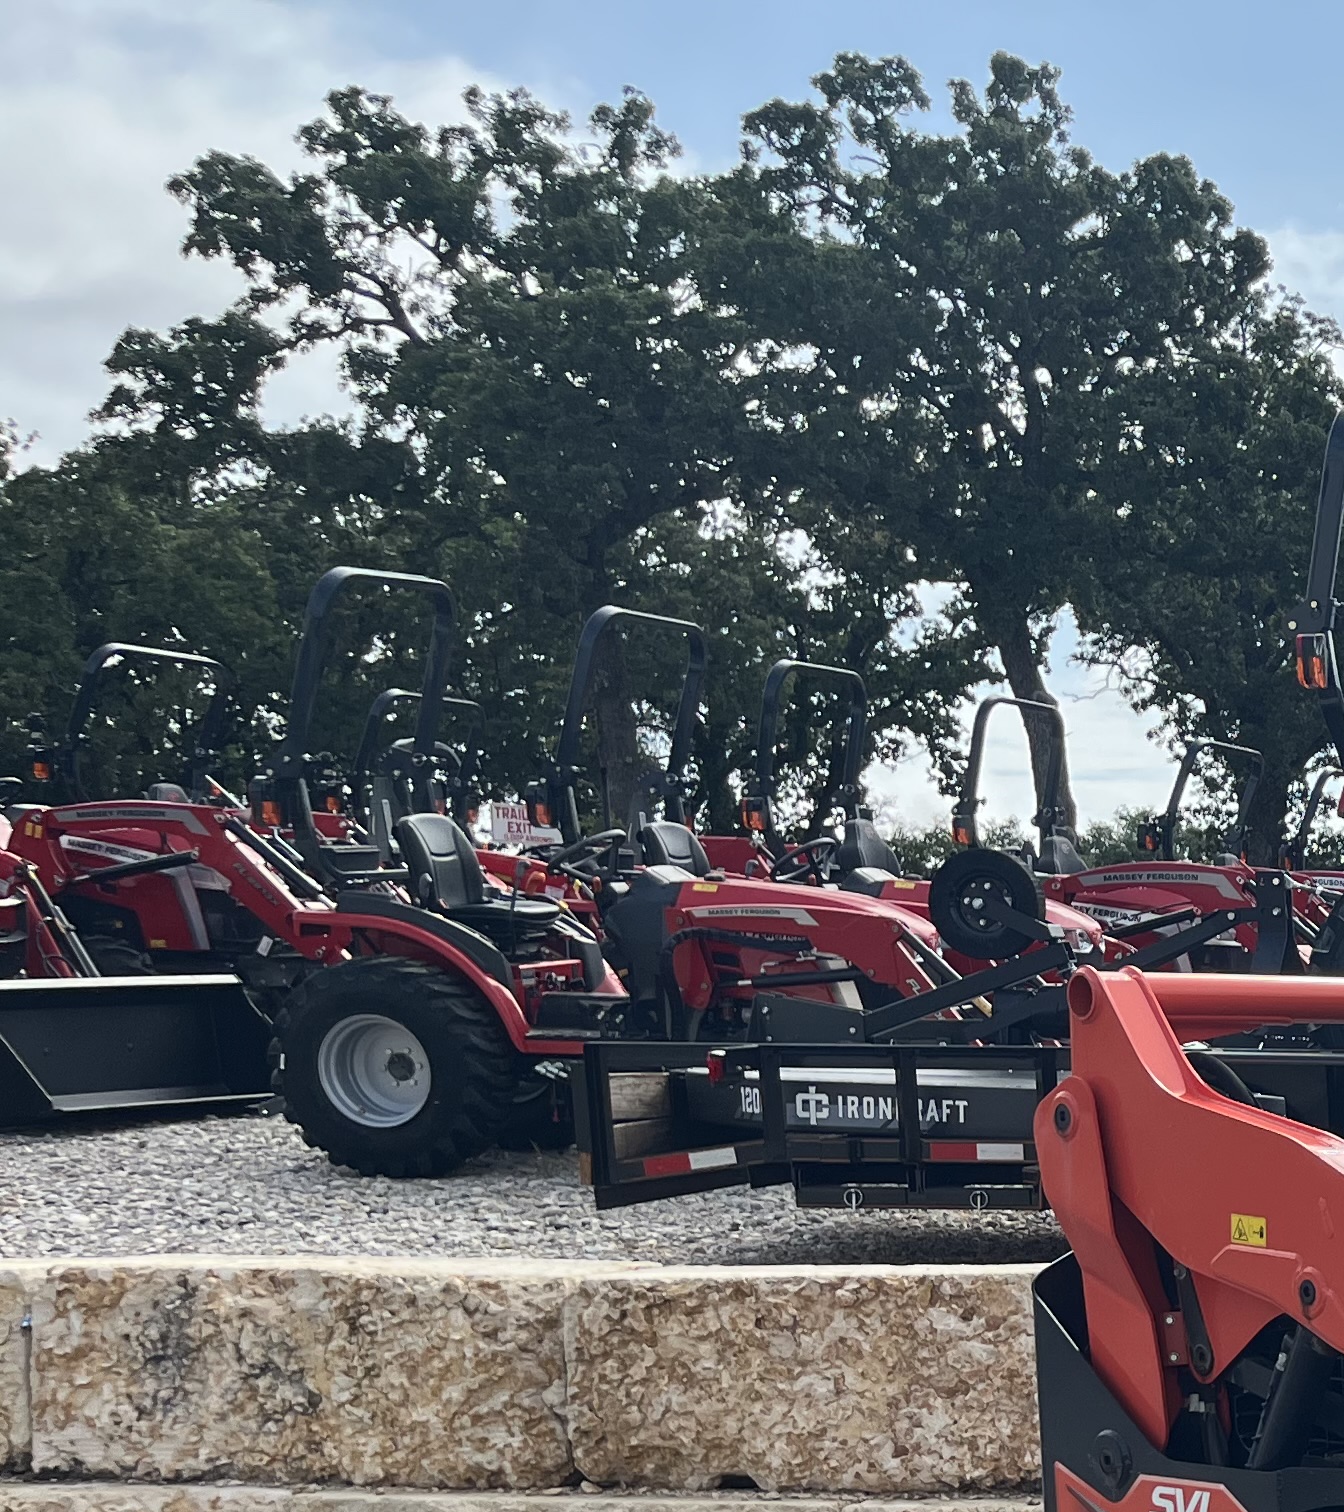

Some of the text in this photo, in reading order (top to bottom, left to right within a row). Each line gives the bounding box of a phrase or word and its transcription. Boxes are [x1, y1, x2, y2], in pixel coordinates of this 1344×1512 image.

[495, 806, 529, 820] TRAIL
[507, 821, 533, 834] EXIT
[1103, 873, 1199, 882] MASSEY FERGUSON
[740, 1086, 763, 1114] 120
[837, 1095, 969, 1123] IRONAFT
